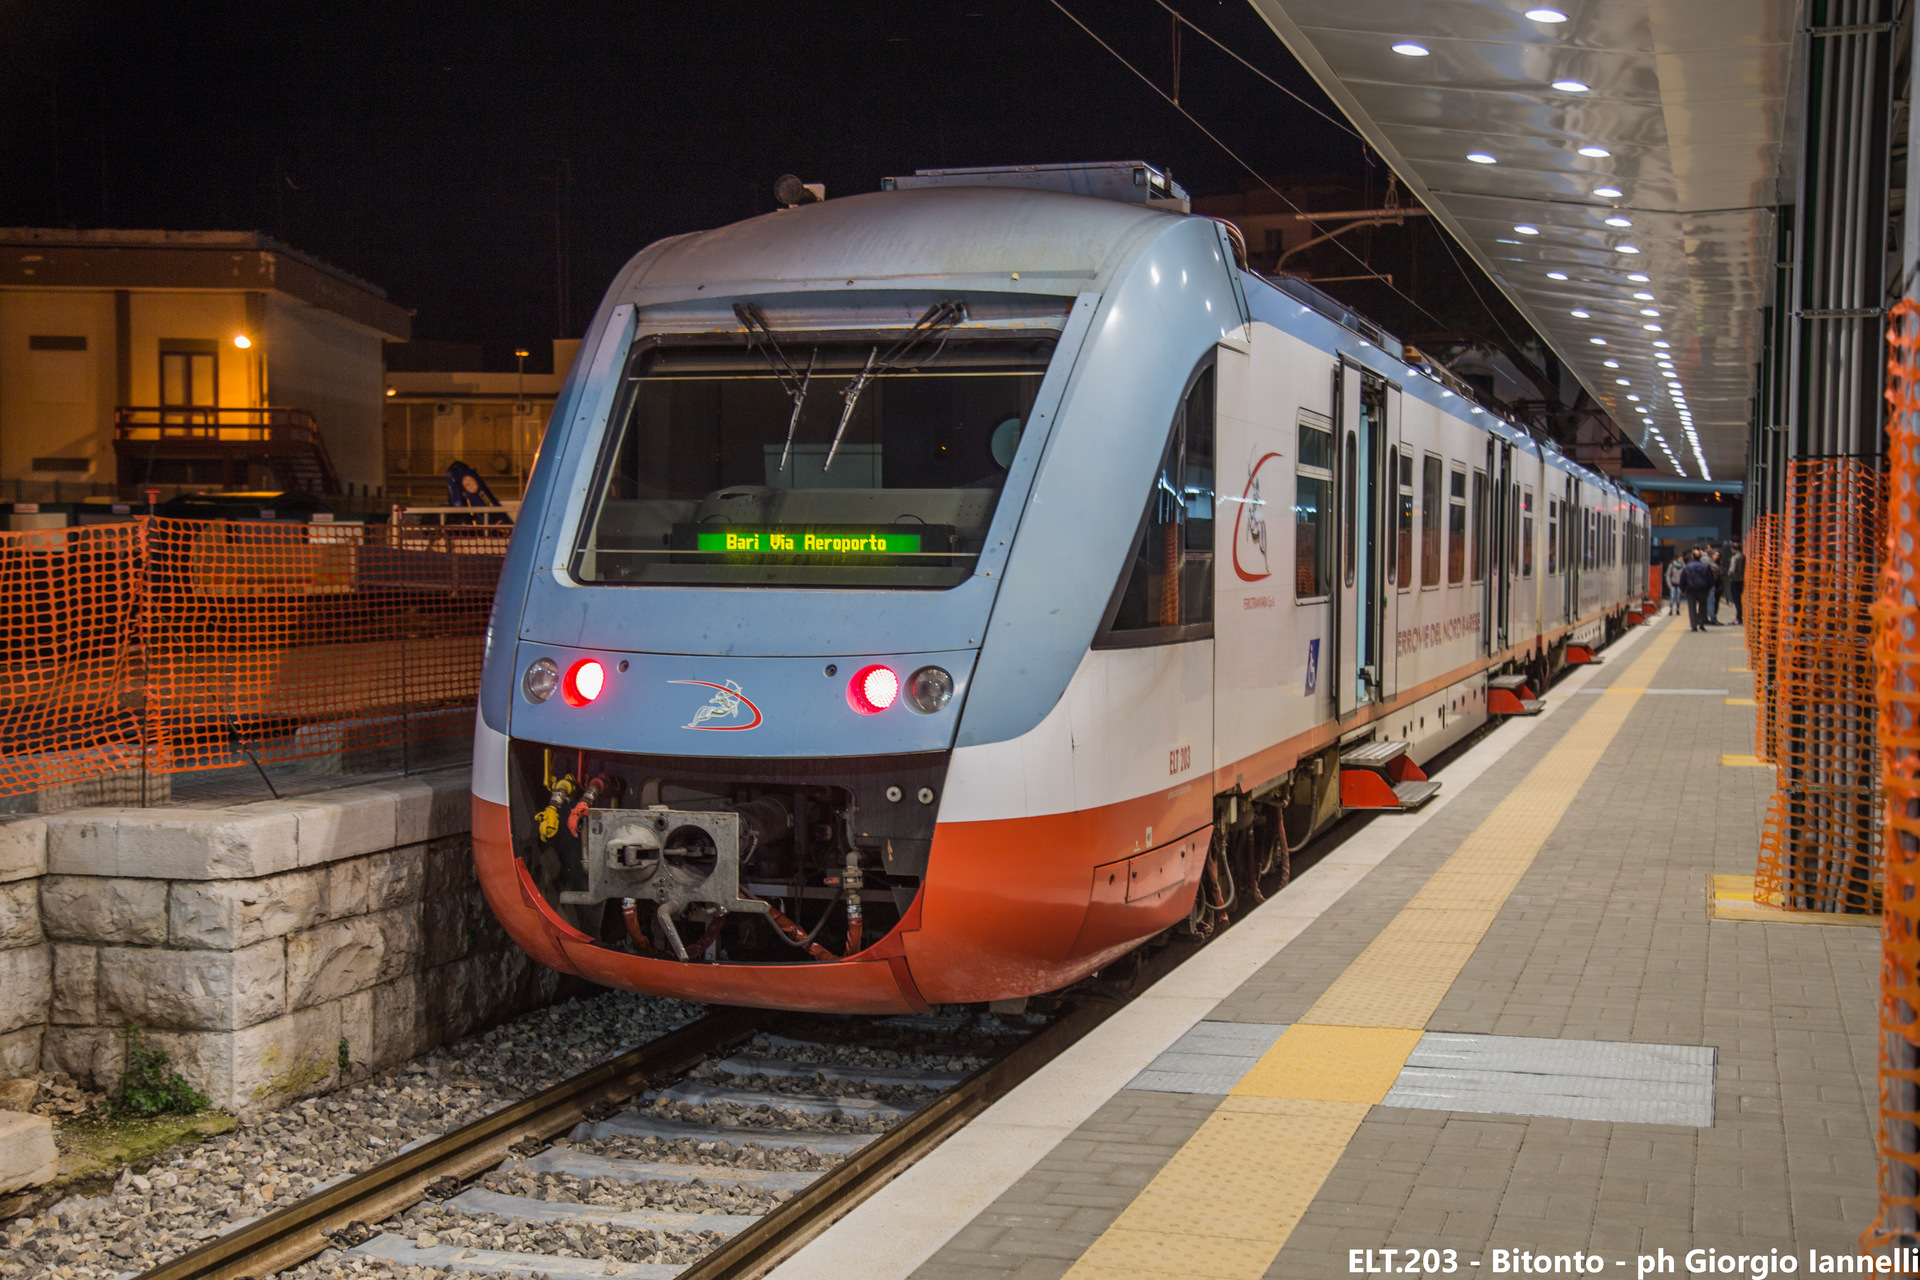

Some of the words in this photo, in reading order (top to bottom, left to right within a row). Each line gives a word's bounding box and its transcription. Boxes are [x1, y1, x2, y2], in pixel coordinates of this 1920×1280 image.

[726, 533, 759, 550] Bari
[769, 534, 794, 550] Via
[804, 534, 887, 553] Aeroporto
[1397, 625, 1429, 657] ERROVIE
[1169, 749, 1179, 775] ELT
[1180, 745, 1191, 772] 203
